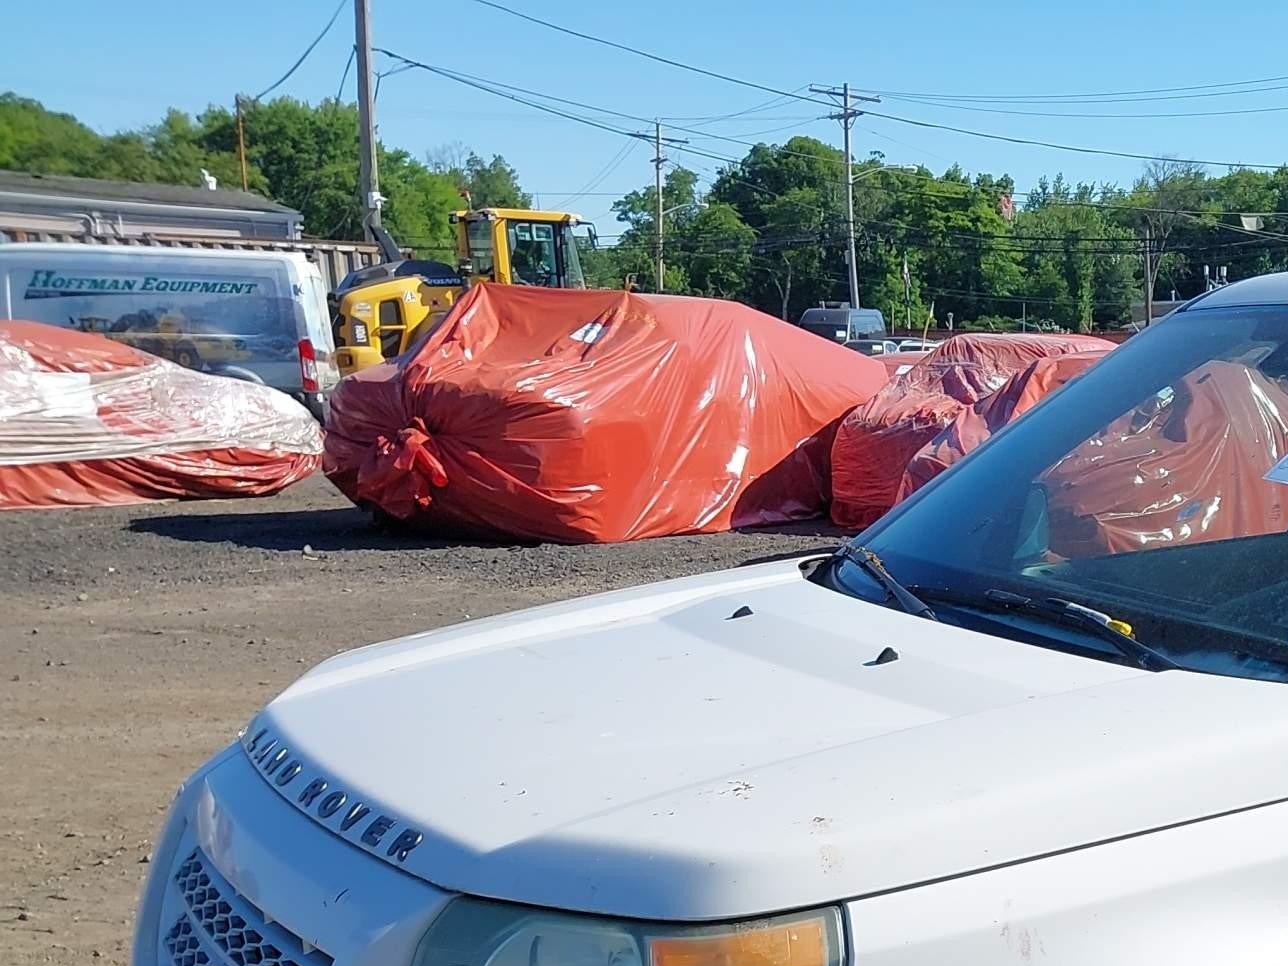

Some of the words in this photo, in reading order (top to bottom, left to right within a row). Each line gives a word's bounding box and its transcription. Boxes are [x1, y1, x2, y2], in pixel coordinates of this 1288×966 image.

[140, 277, 257, 295] EQUIPMENT
[246, 728, 303, 787] LAND
[299, 777, 424, 862] ROVER
